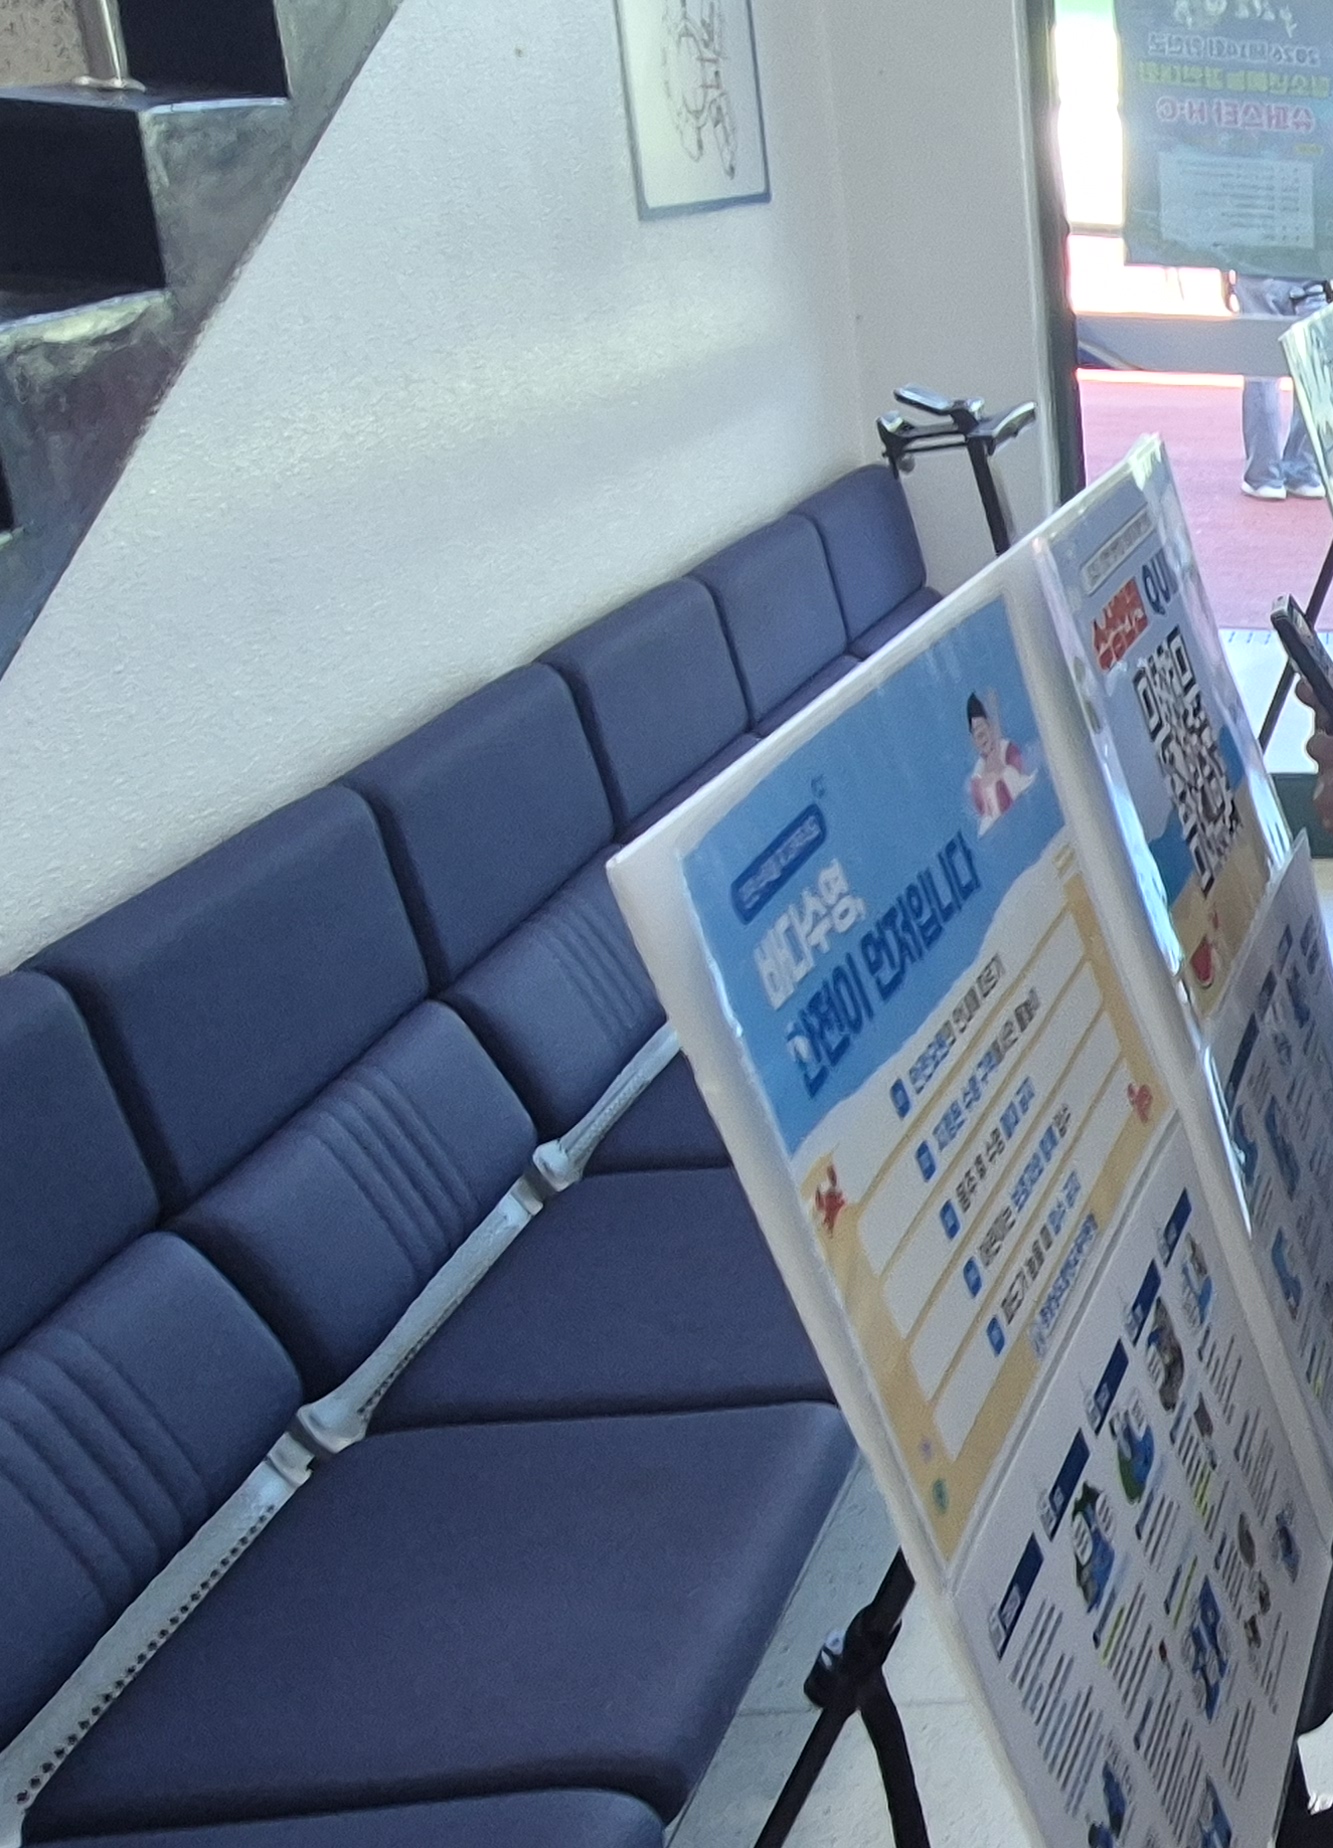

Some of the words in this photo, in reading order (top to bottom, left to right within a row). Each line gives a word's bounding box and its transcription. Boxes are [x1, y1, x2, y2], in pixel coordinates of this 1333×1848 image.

[1142, 548, 1178, 615] QUI
[751, 856, 868, 1013] 바다수영,
[783, 950, 874, 1098] 안전이
[858, 828, 981, 1003] 먼저입니다
